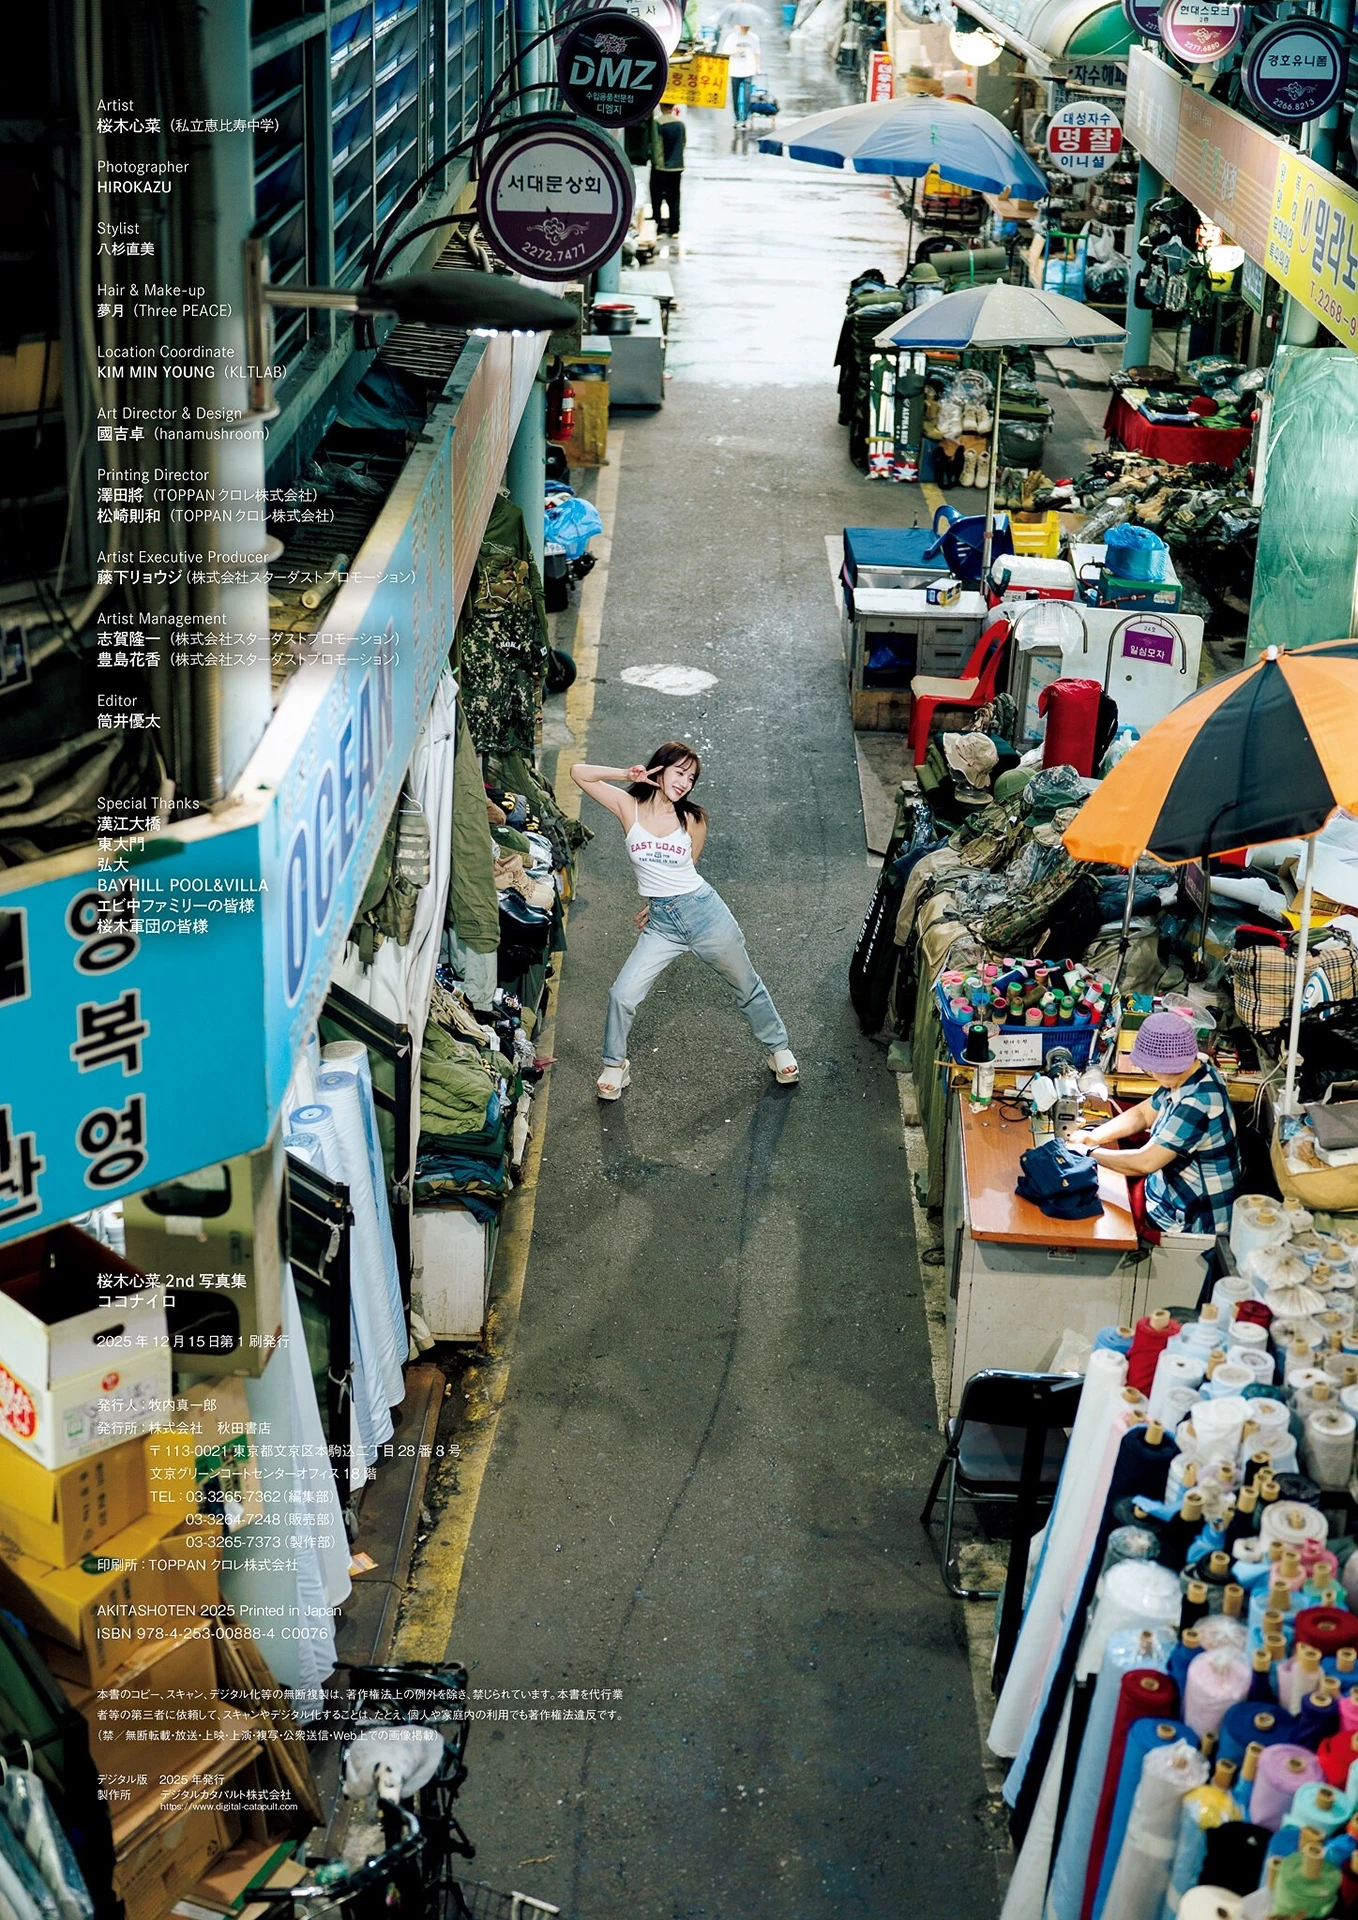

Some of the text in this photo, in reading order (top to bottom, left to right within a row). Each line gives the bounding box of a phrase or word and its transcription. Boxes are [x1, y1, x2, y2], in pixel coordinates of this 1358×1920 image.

[1268, 55, 1328, 68] 경호유니폼
[569, 55, 657, 91] DMZ
[596, 104, 622, 115] 디엠지
[1272, 97, 1315, 111] 2266.8213
[1063, 113, 1111, 126] 대성자수
[1058, 129, 1114, 152] 명찰
[1061, 156, 1105, 168] 이니셜
[508, 174, 602, 194] 서대문상회
[521, 241, 586, 262] 2272.7477
[1312, 197, 1358, 291] 밀라노
[1130, 645, 1165, 660] 일심모자
[282, 612, 394, 1008] OCEAN
[631, 841, 686, 856] EAST COAST
